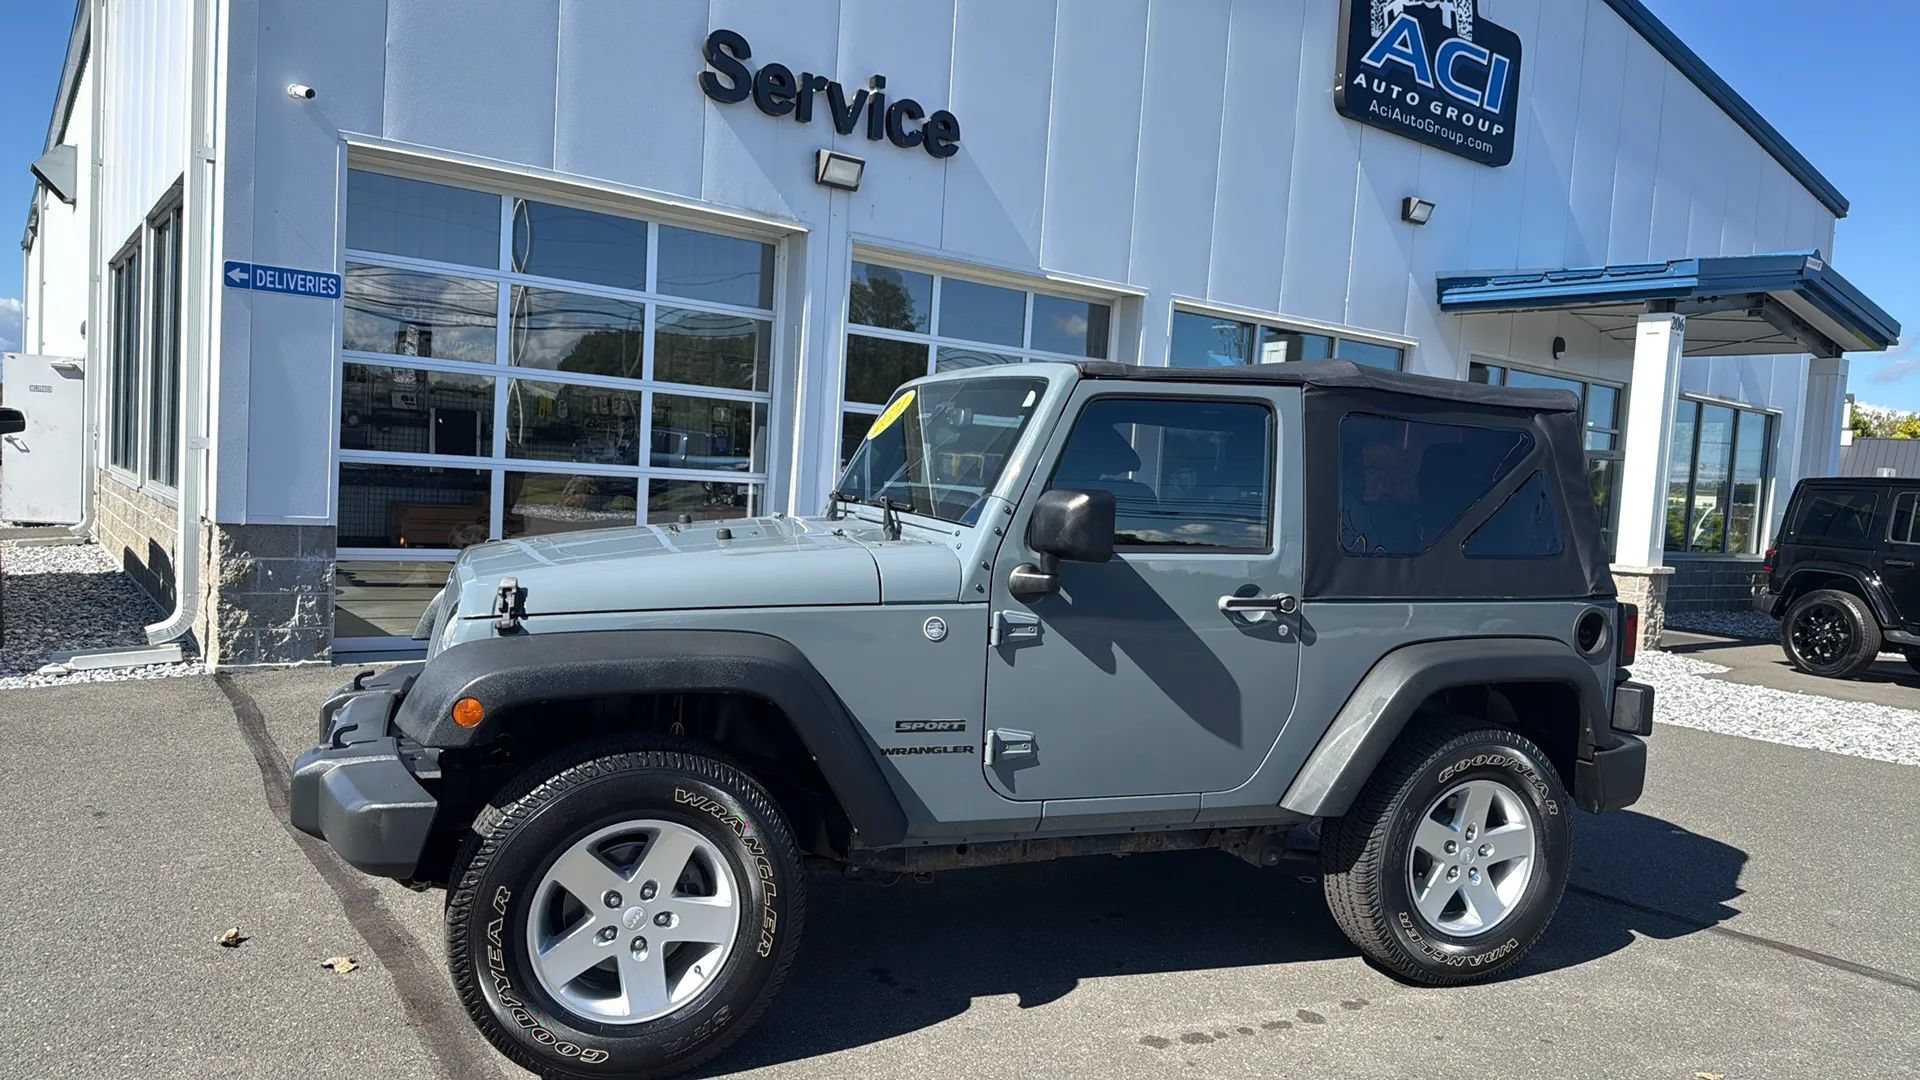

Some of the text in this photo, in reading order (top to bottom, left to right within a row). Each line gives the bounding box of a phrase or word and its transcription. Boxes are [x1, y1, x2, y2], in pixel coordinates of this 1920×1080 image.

[1360, 12, 1510, 114] ACI
[699, 29, 961, 159] Service
[1353, 73, 1505, 136] AUTO GROUP
[1369, 99, 1493, 154] AciAutoGroup.com
[256, 269, 337, 295] DELIVERIES
[1671, 315, 1685, 332] 206
[880, 745, 975, 756] WRANGLER
[899, 721, 965, 731] SPORT
[1438, 754, 1559, 815] GOODYEAR
[675, 788, 778, 958] WRANGLER
[1398, 911, 1519, 967] WRANGLER
[487, 885, 609, 1064] GOODYEAR
